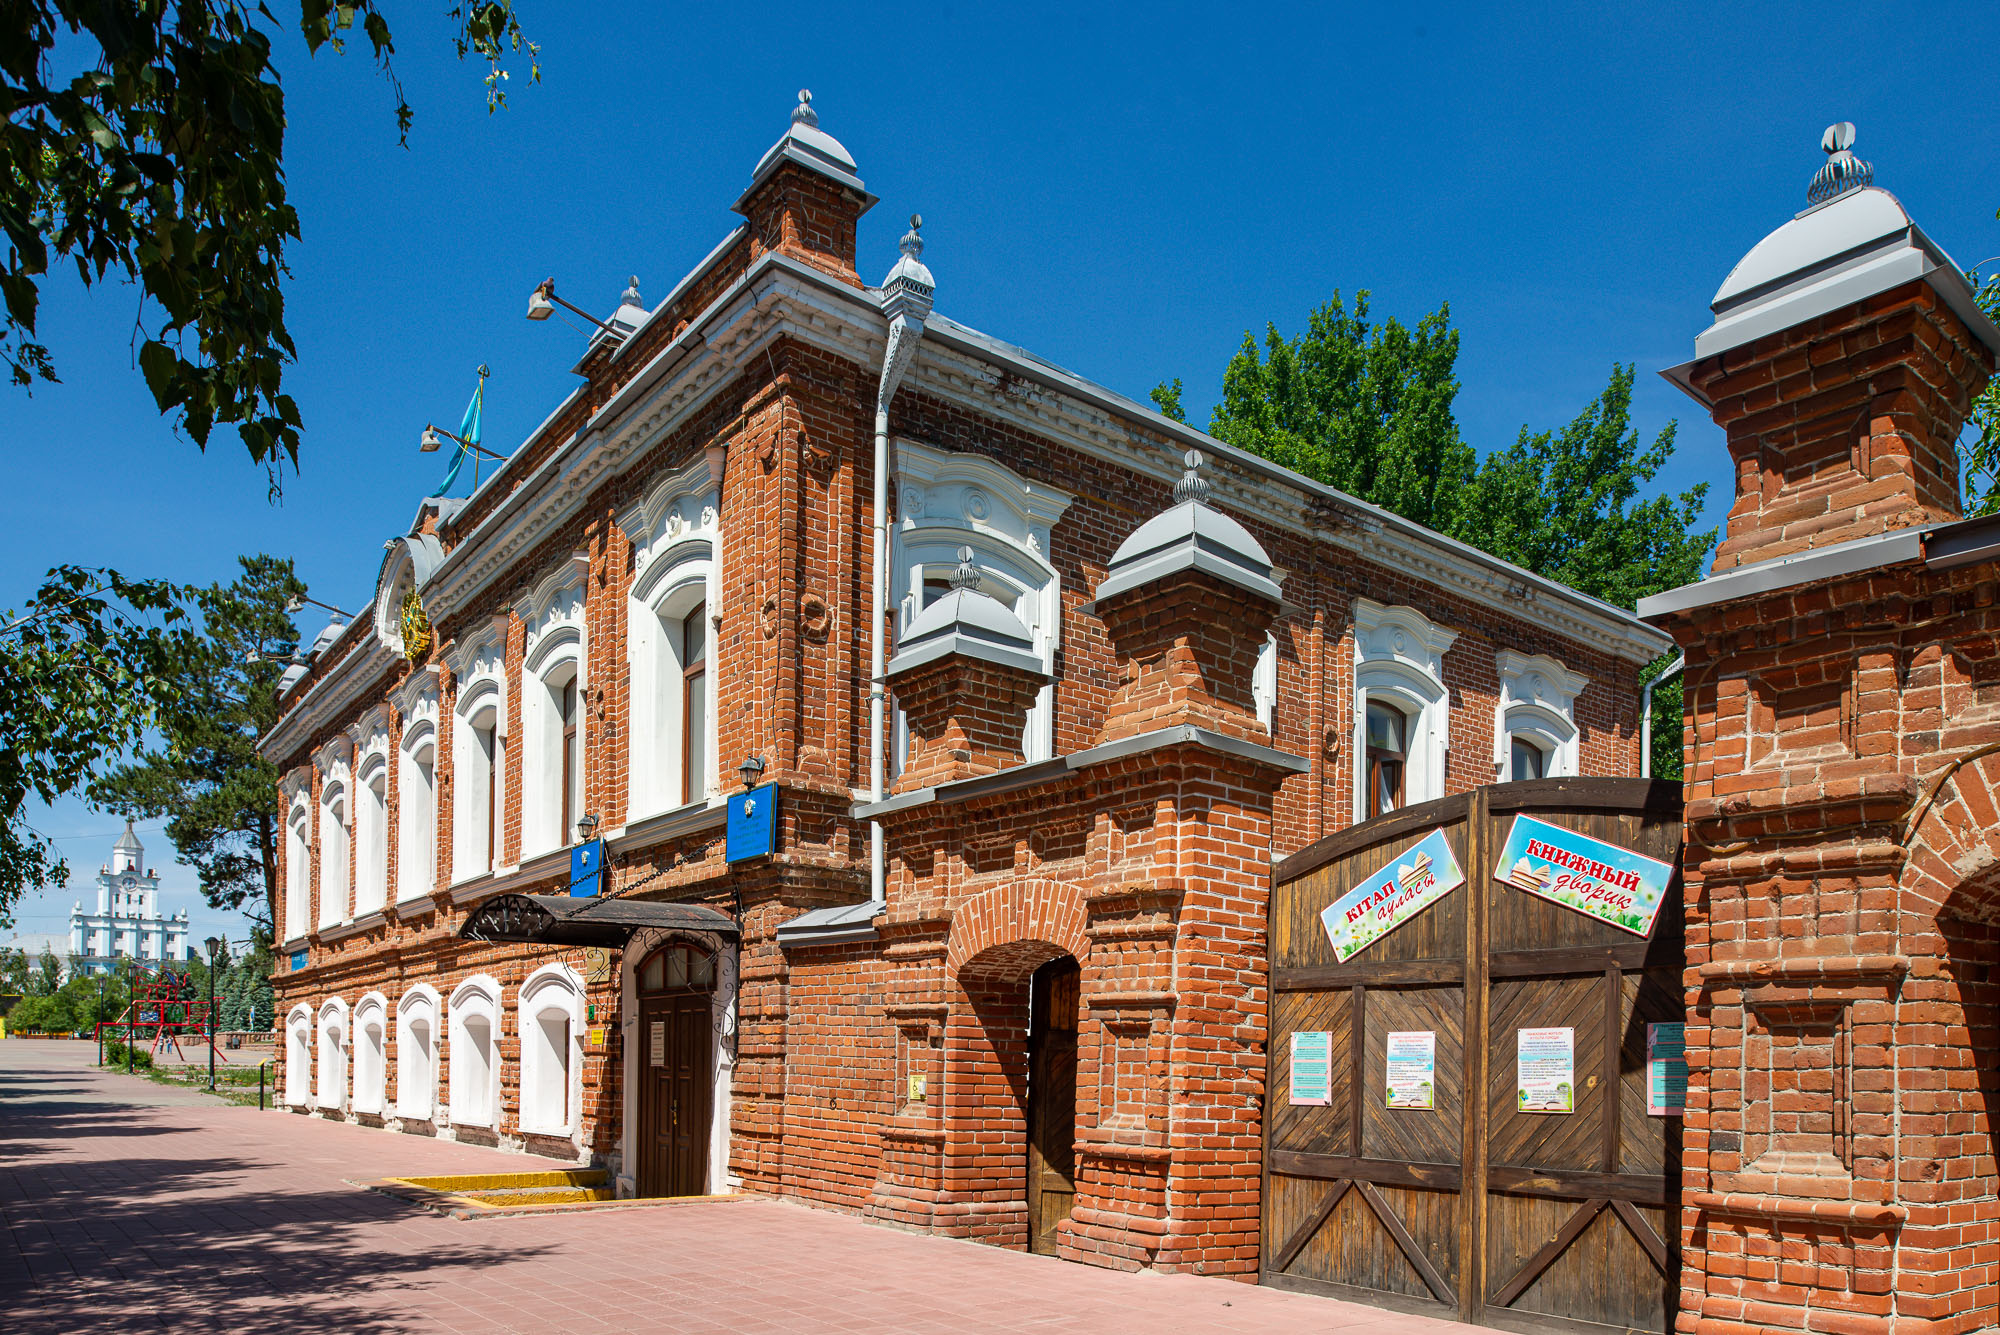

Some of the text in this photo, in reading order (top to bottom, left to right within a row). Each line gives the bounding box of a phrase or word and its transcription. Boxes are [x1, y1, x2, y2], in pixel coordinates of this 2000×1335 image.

[1526, 839, 1641, 892] КНИЖНЫЙ
[1345, 881, 1396, 923] КІТАП
[1377, 873, 1436, 921] ауласы
[1553, 871, 1632, 910] дворик
